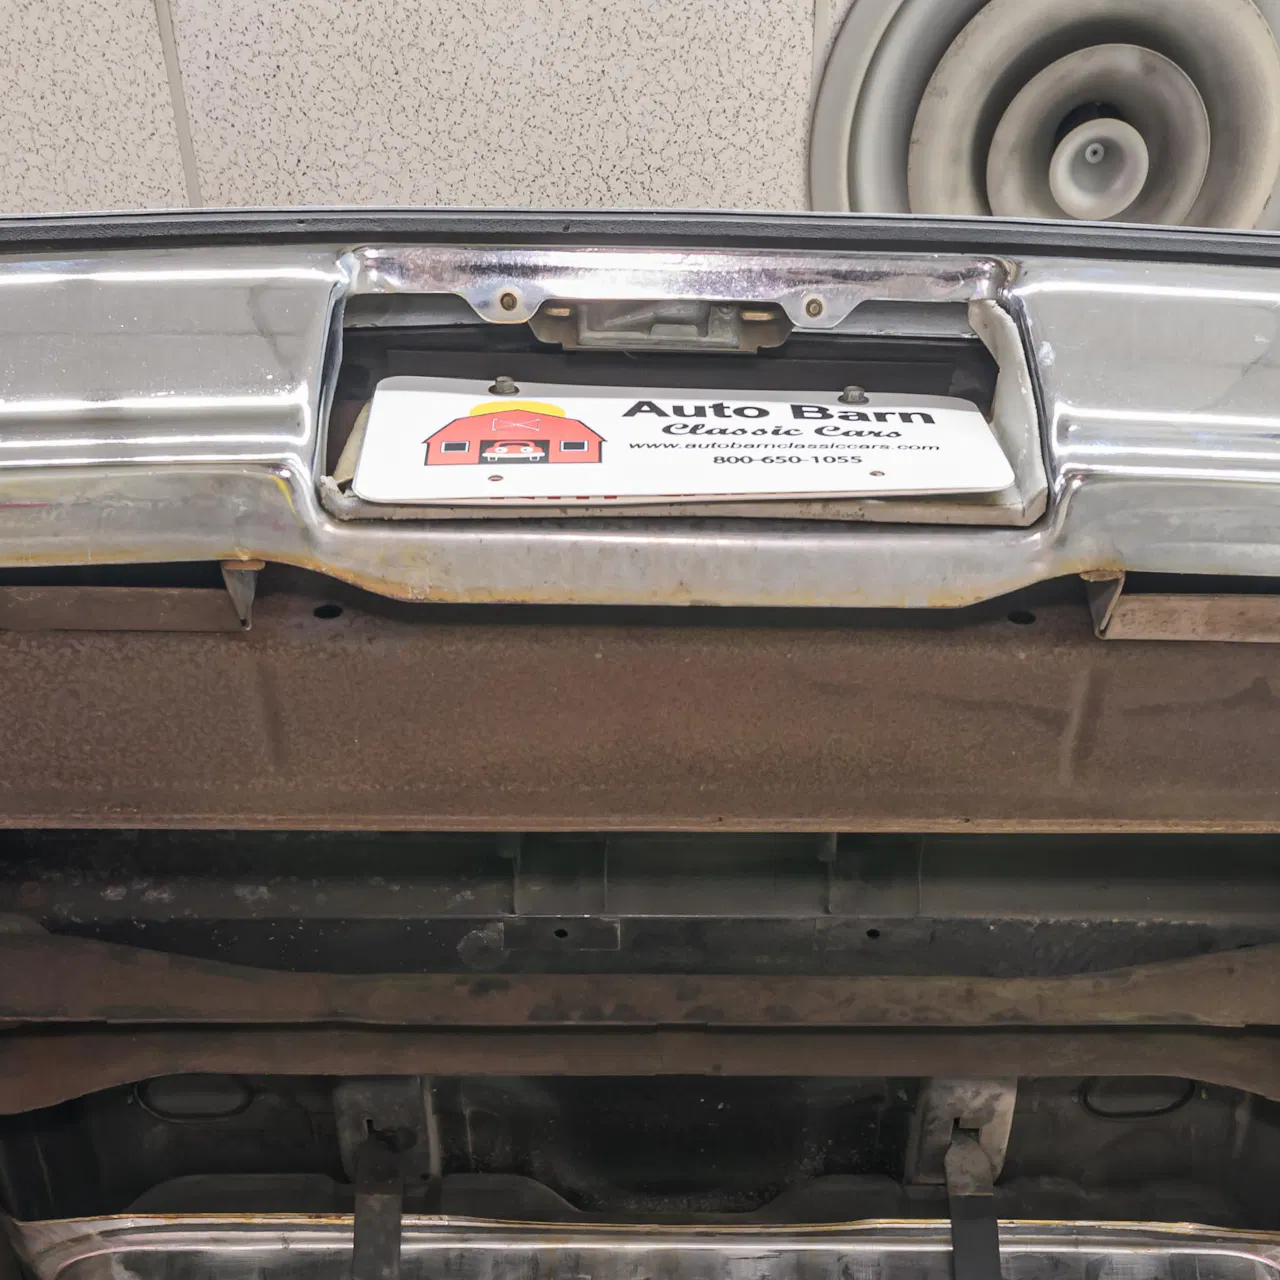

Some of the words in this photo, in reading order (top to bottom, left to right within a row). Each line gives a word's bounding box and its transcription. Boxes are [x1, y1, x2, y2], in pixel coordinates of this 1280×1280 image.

[622, 401, 770, 419] Auto
[790, 404, 936, 424] Barn
[662, 423, 803, 436] Classic
[814, 425, 902, 438] Cars
[629, 442, 940, 451] www.autobarnclassiccars.com
[713, 455, 862, 464] 800-650-1055
